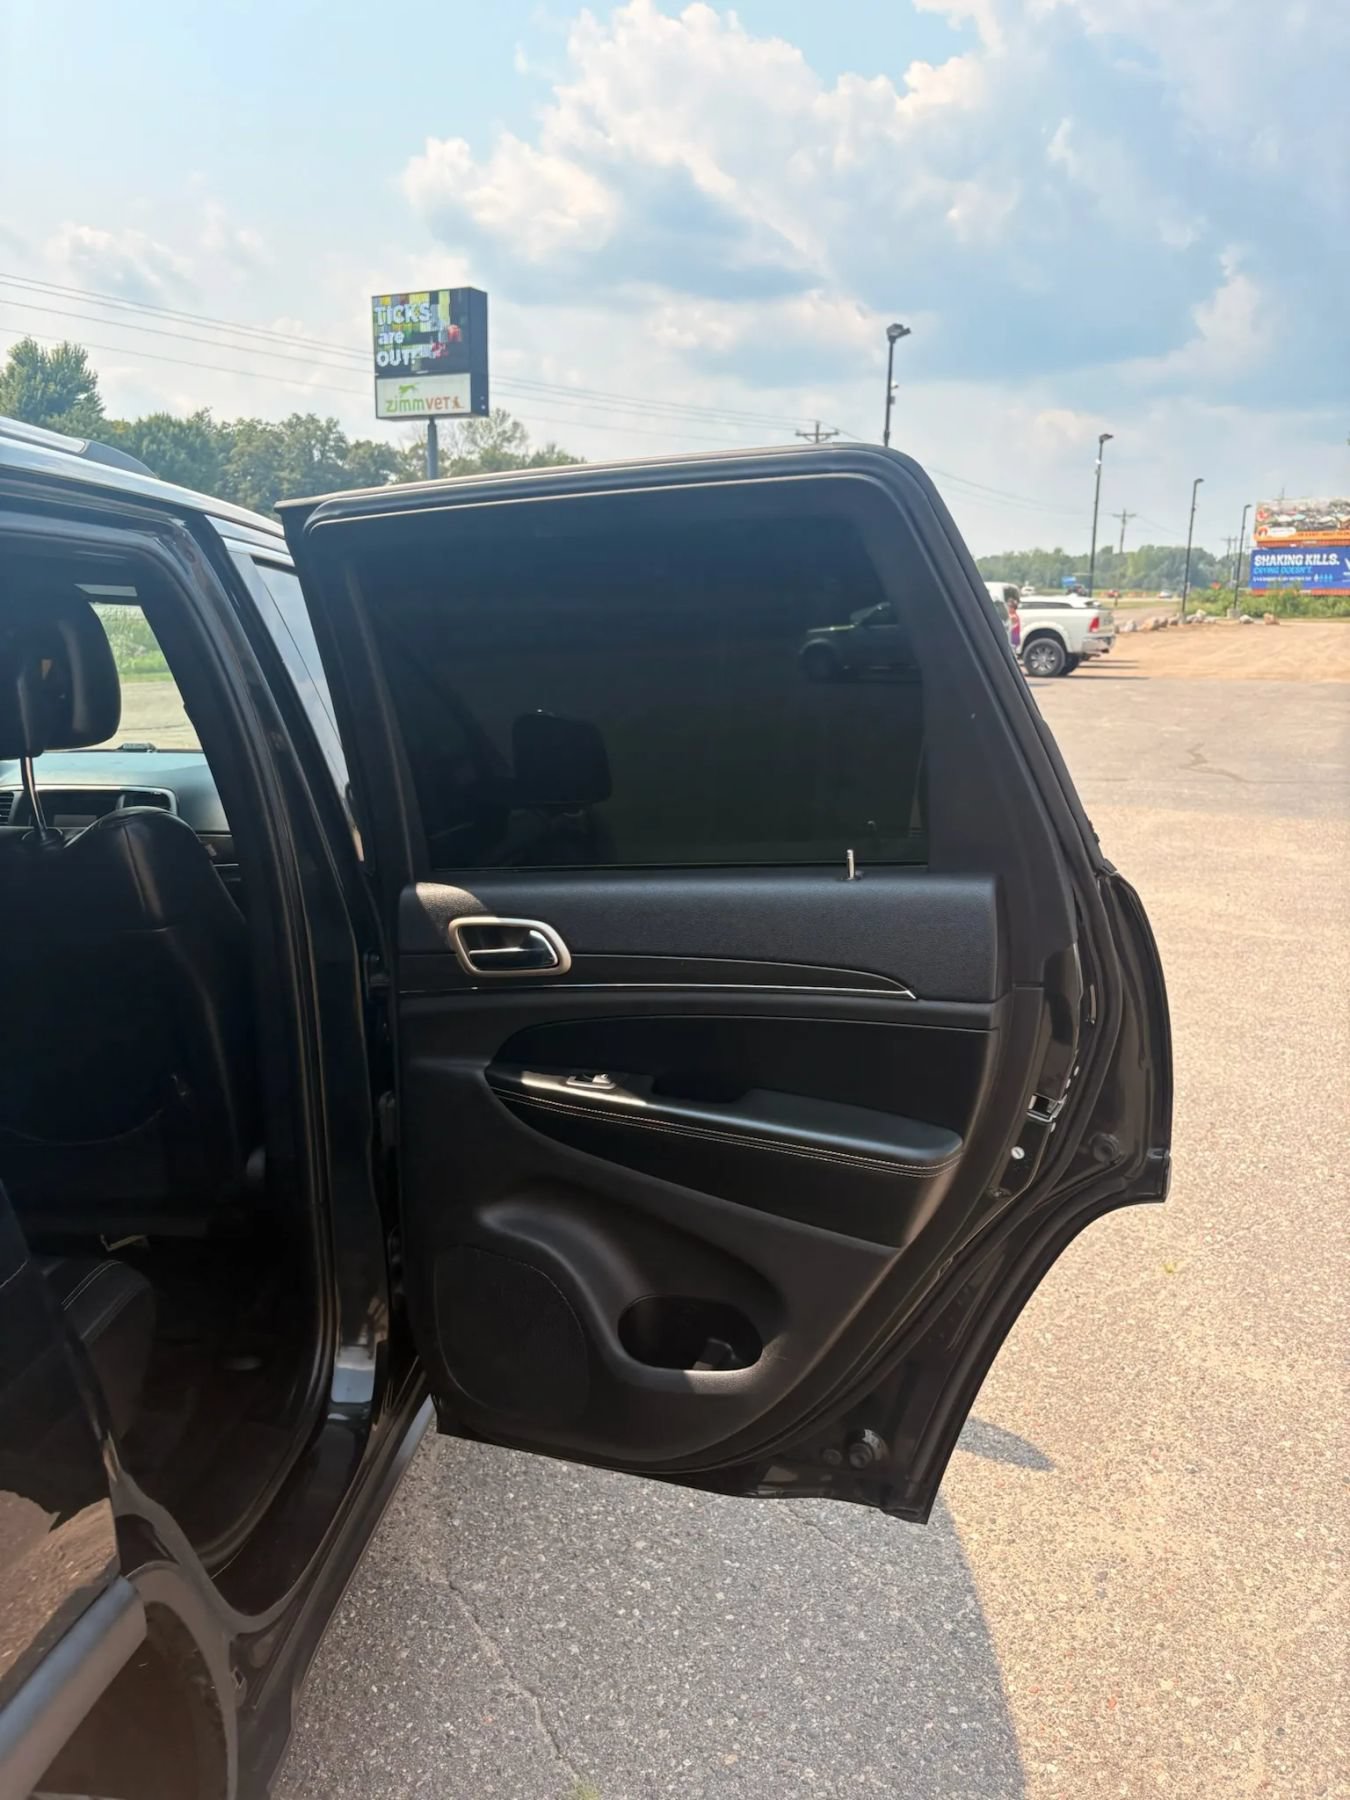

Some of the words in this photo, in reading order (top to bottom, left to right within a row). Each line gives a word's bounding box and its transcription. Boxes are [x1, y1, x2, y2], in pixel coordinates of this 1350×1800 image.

[375, 303, 430, 325] TICKS
[378, 331, 404, 344] are
[1254, 554, 1304, 567] SHAKING
[1305, 553, 1340, 566] KILLS.
